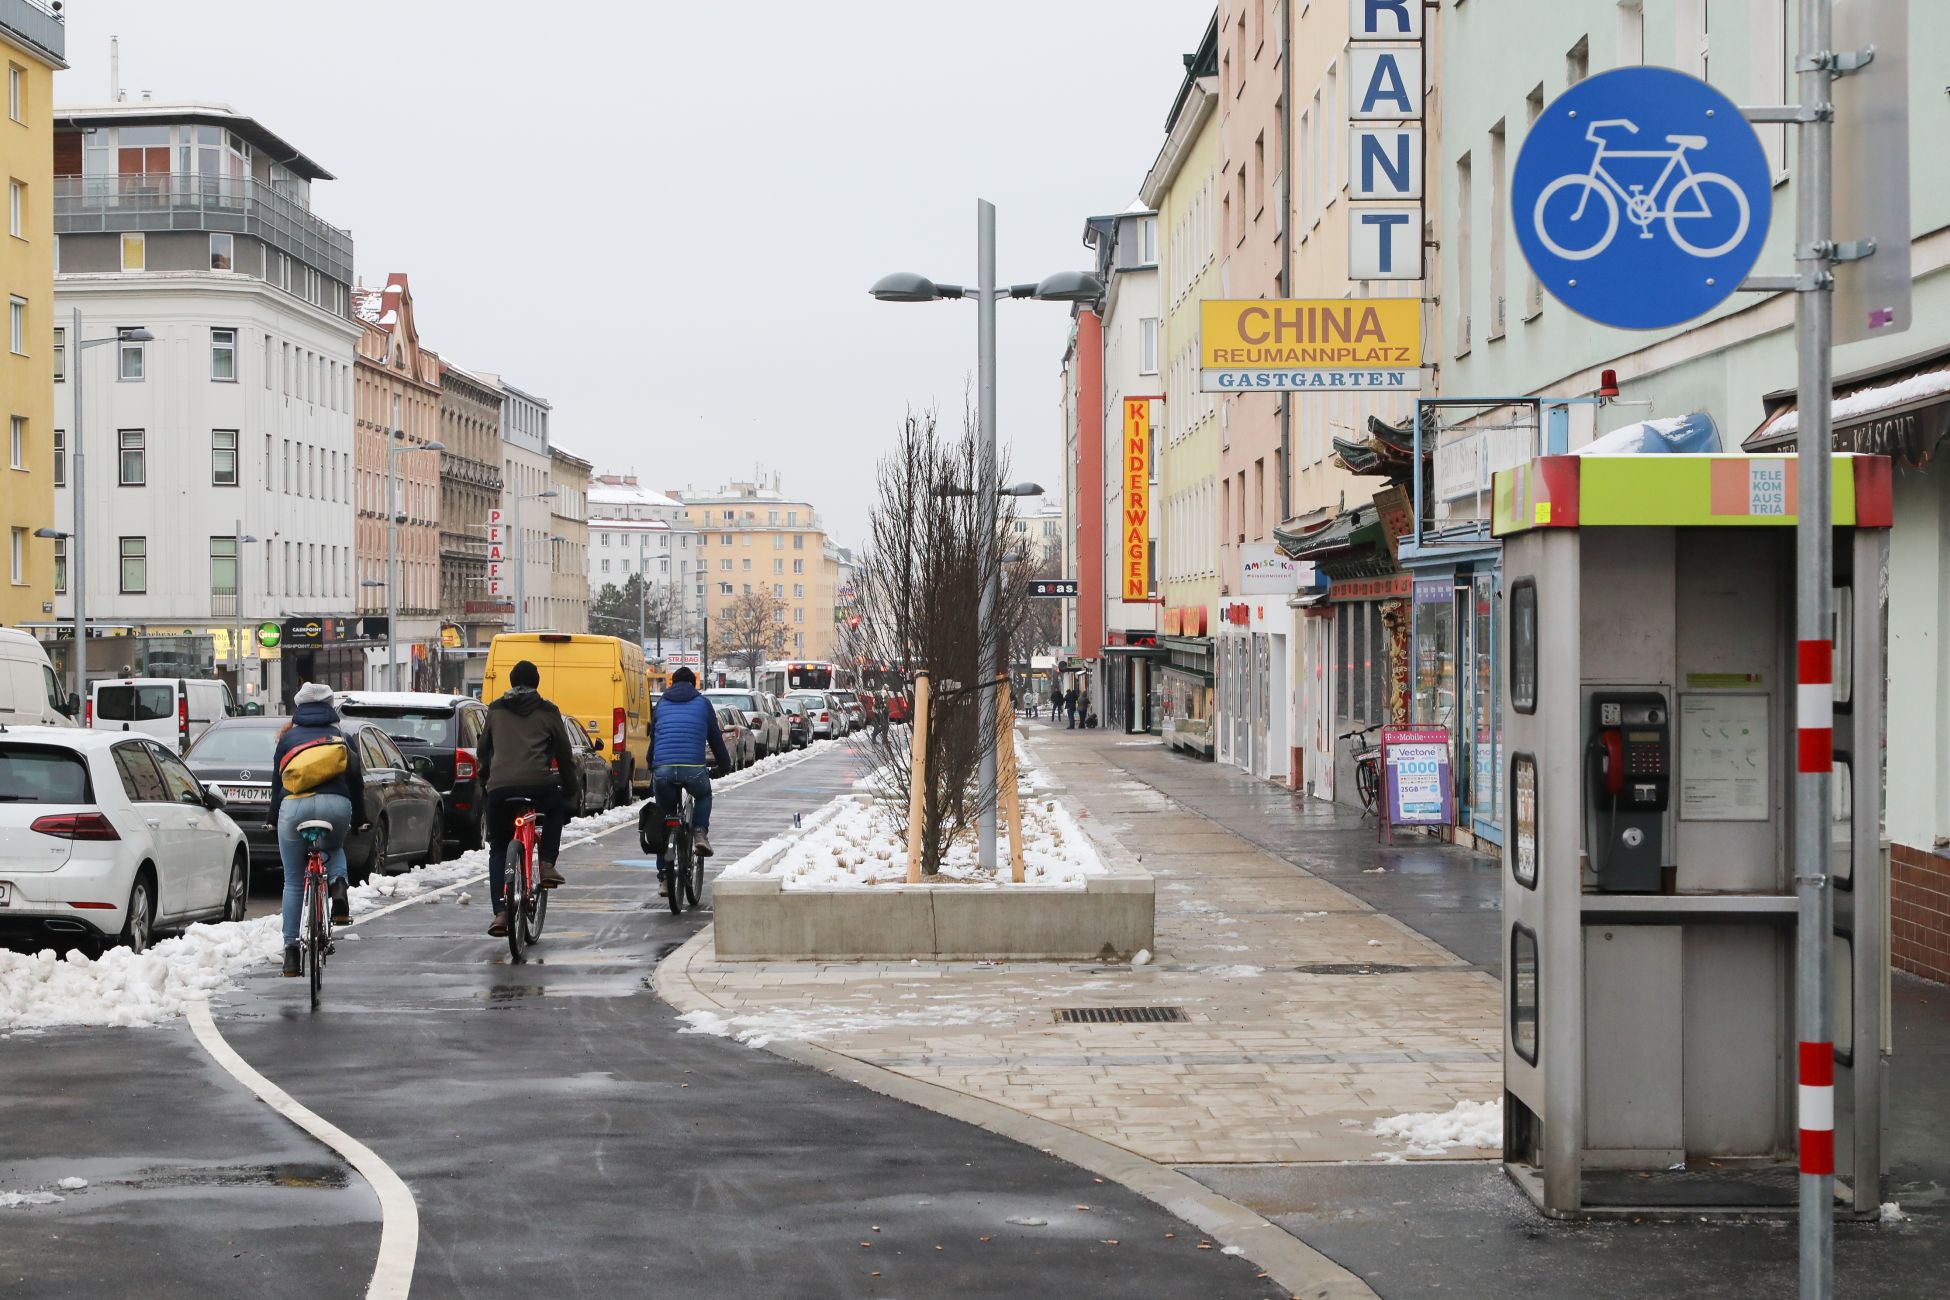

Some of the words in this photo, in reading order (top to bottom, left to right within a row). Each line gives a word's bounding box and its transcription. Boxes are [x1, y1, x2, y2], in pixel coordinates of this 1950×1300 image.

[1237, 306, 1387, 345] CHINA
[1213, 347, 1410, 363] REUMANNPLATZ
[1218, 372, 1405, 387] GASTGARTEN
[1752, 470, 1782, 480] TELE
[1753, 481, 1782, 491] KOM
[1125, 403, 1146, 596] KINDERWAGEN
[1753, 493, 1782, 503] AUS
[1752, 503, 1783, 514] TRIA
[490, 510, 500, 594] PFAFF
[1398, 748, 1436, 756] Vectone
[1399, 761, 1438, 774] 1000
[237, 789, 259, 800] 1407
